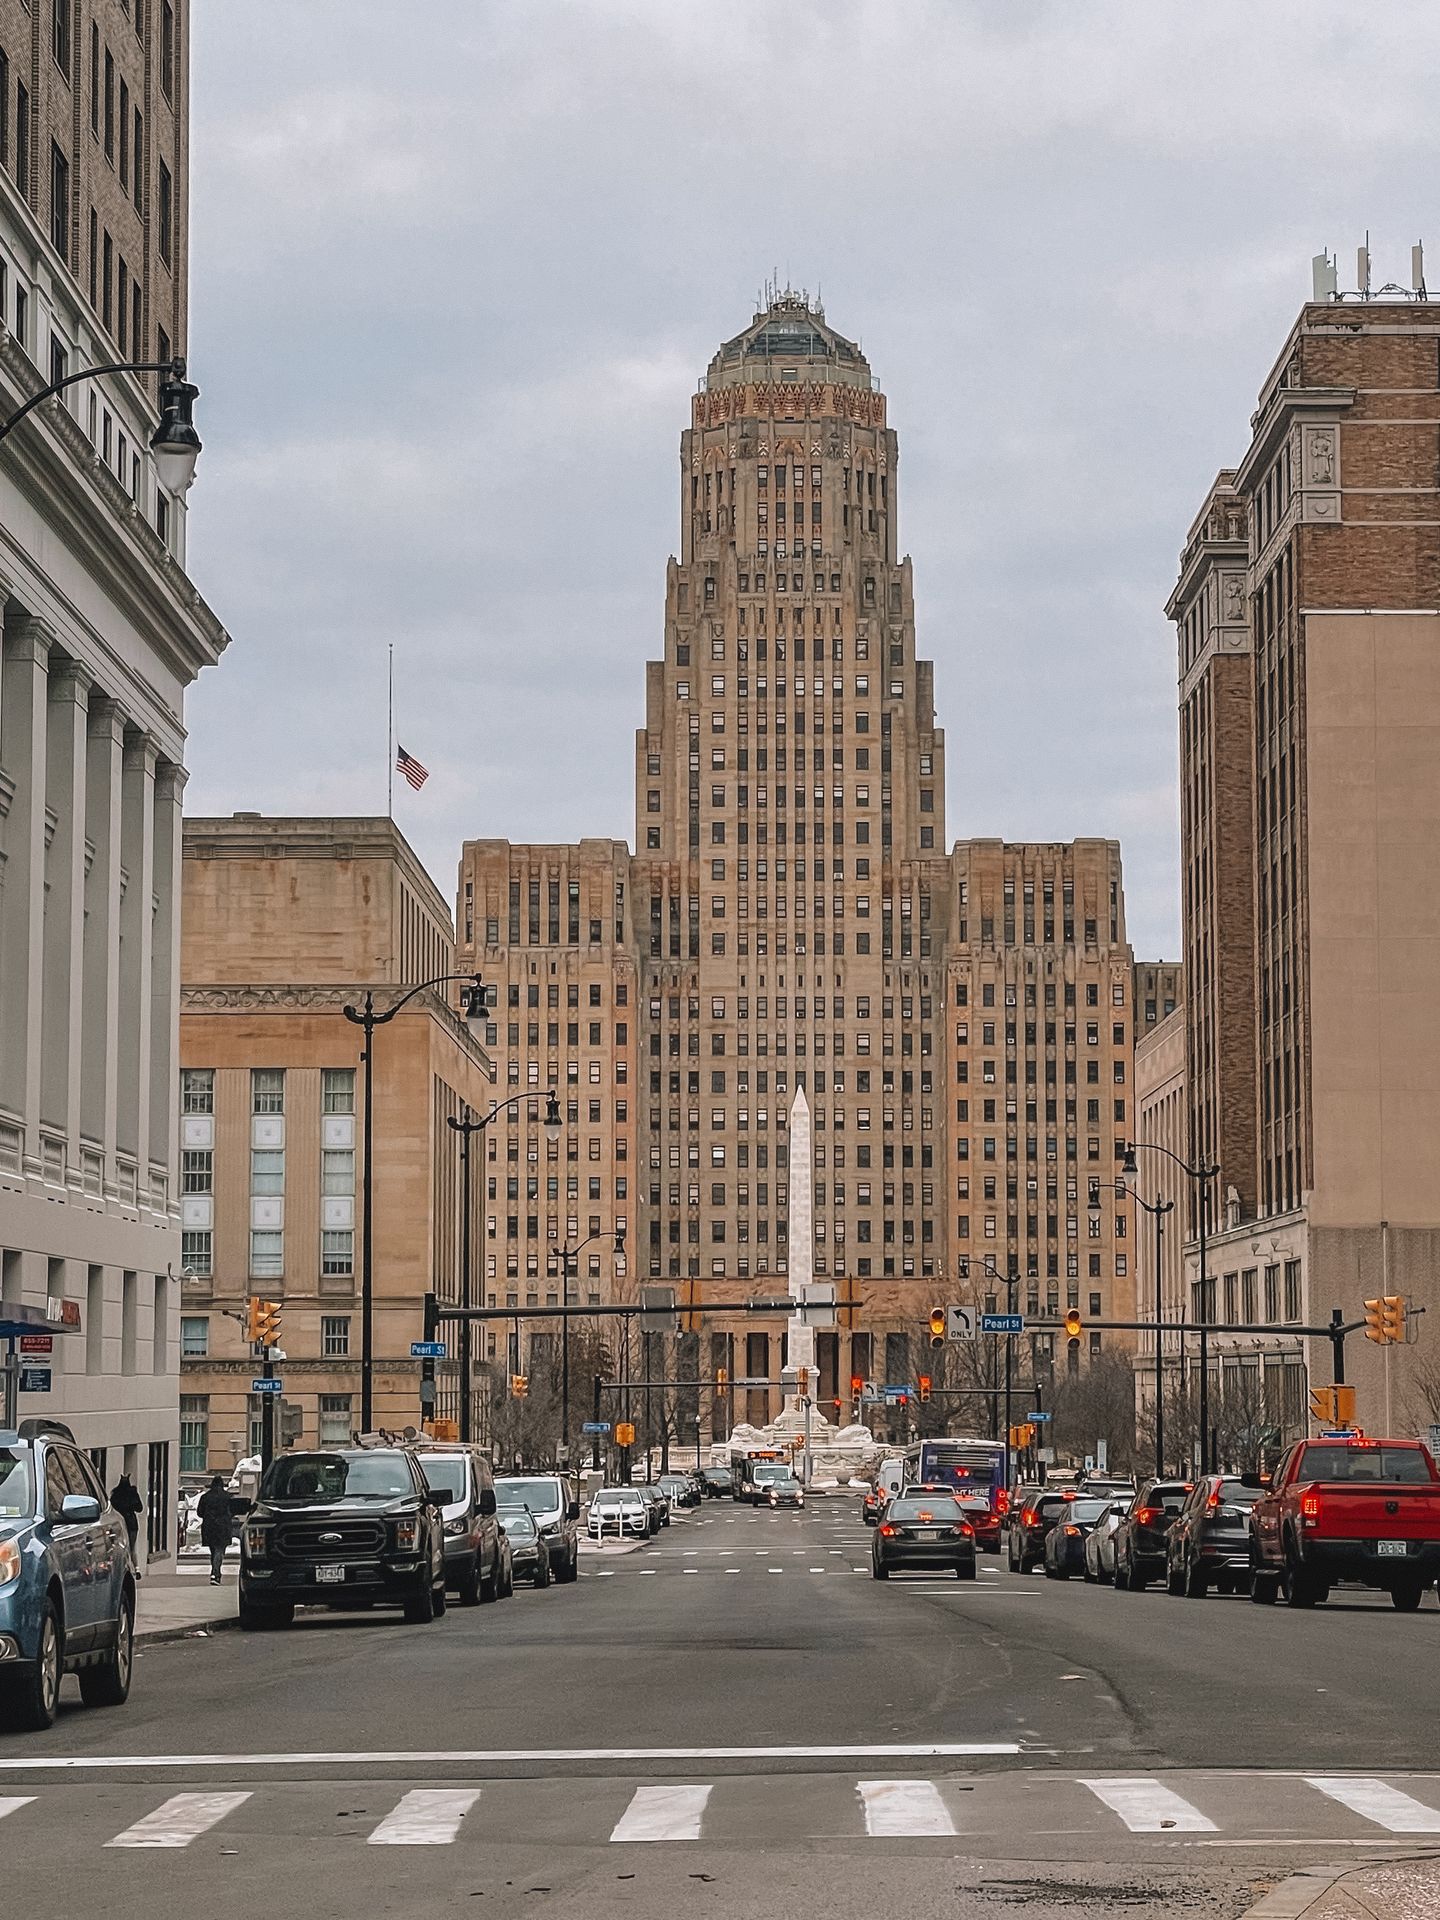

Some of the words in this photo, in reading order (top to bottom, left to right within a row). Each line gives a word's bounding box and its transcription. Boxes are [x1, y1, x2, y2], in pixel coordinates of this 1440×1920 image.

[984, 1319, 1009, 1329] Pearl
[1011, 1319, 1019, 1328] St
[951, 1330, 972, 1338] ONLY
[411, 1344, 431, 1354] Pearl
[436, 1345, 445, 1355] St
[253, 1381, 273, 1390] Pearl
[968, 1487, 990, 1497] HERE
